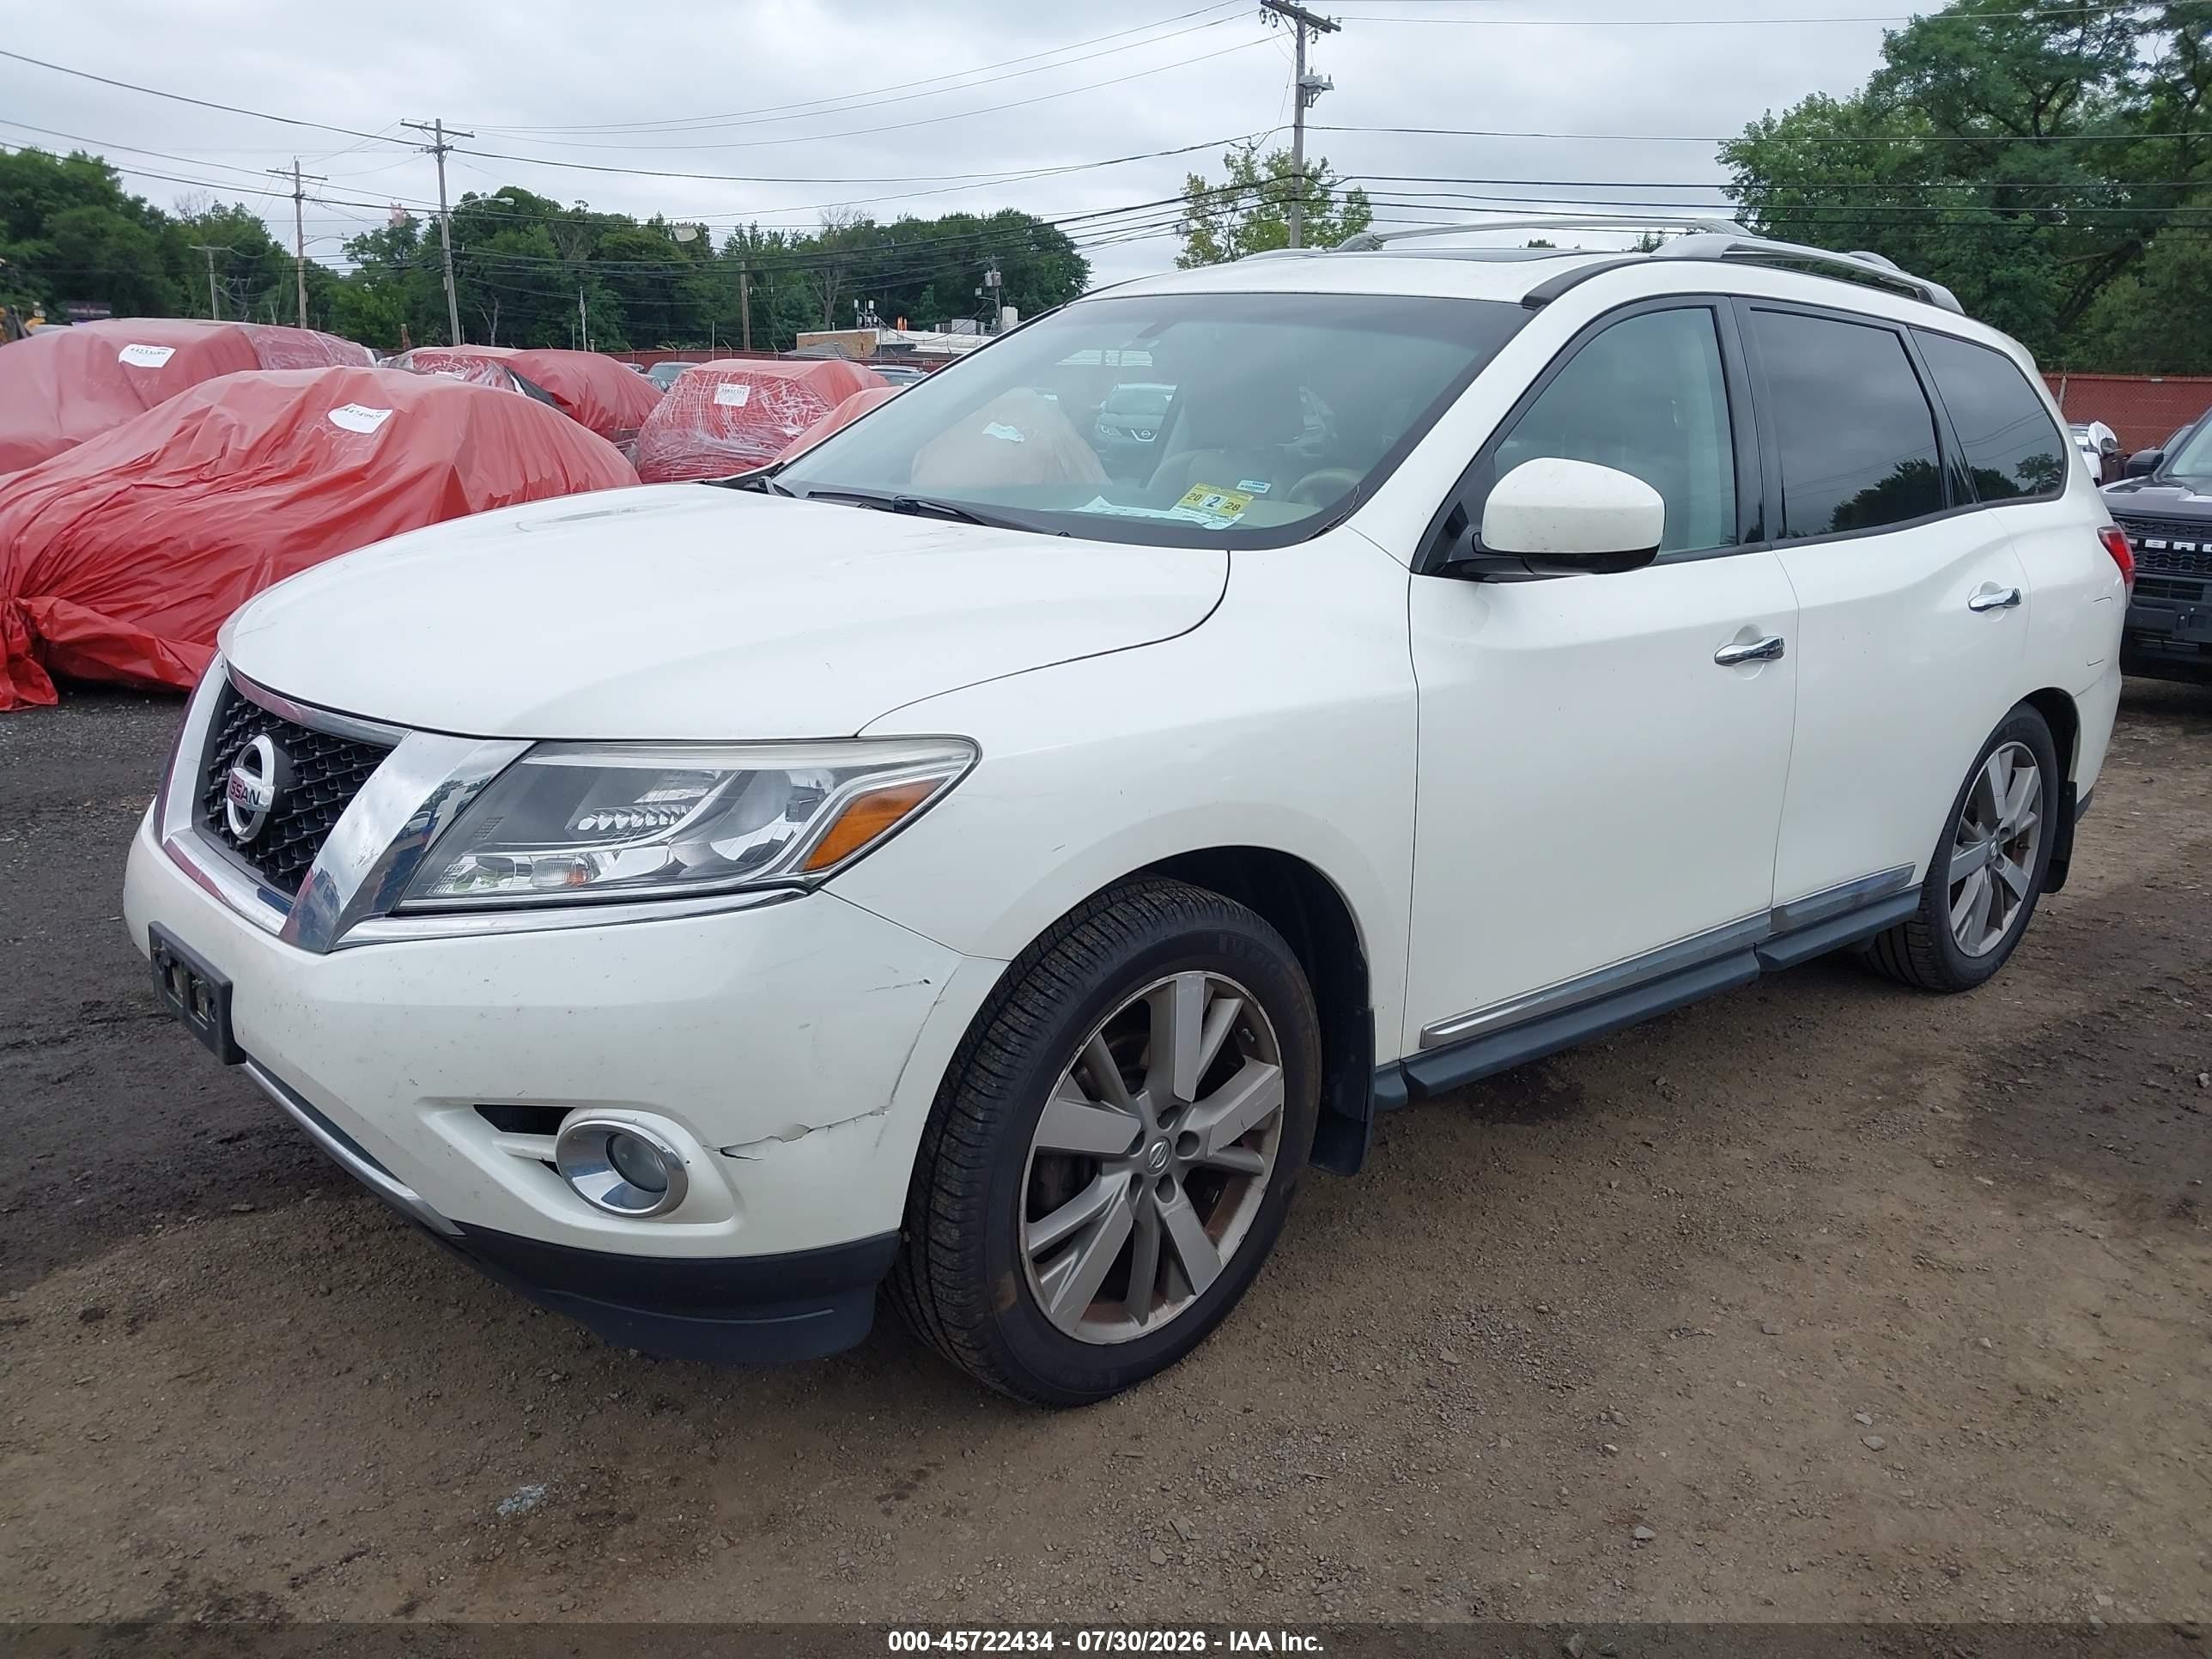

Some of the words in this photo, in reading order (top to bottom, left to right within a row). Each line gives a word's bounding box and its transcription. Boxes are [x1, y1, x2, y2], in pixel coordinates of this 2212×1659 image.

[1187, 493, 1203, 501] 20
[1206, 496, 1221, 507] 2
[1224, 501, 1241, 511] 28
[230, 781, 261, 805] SSAN
